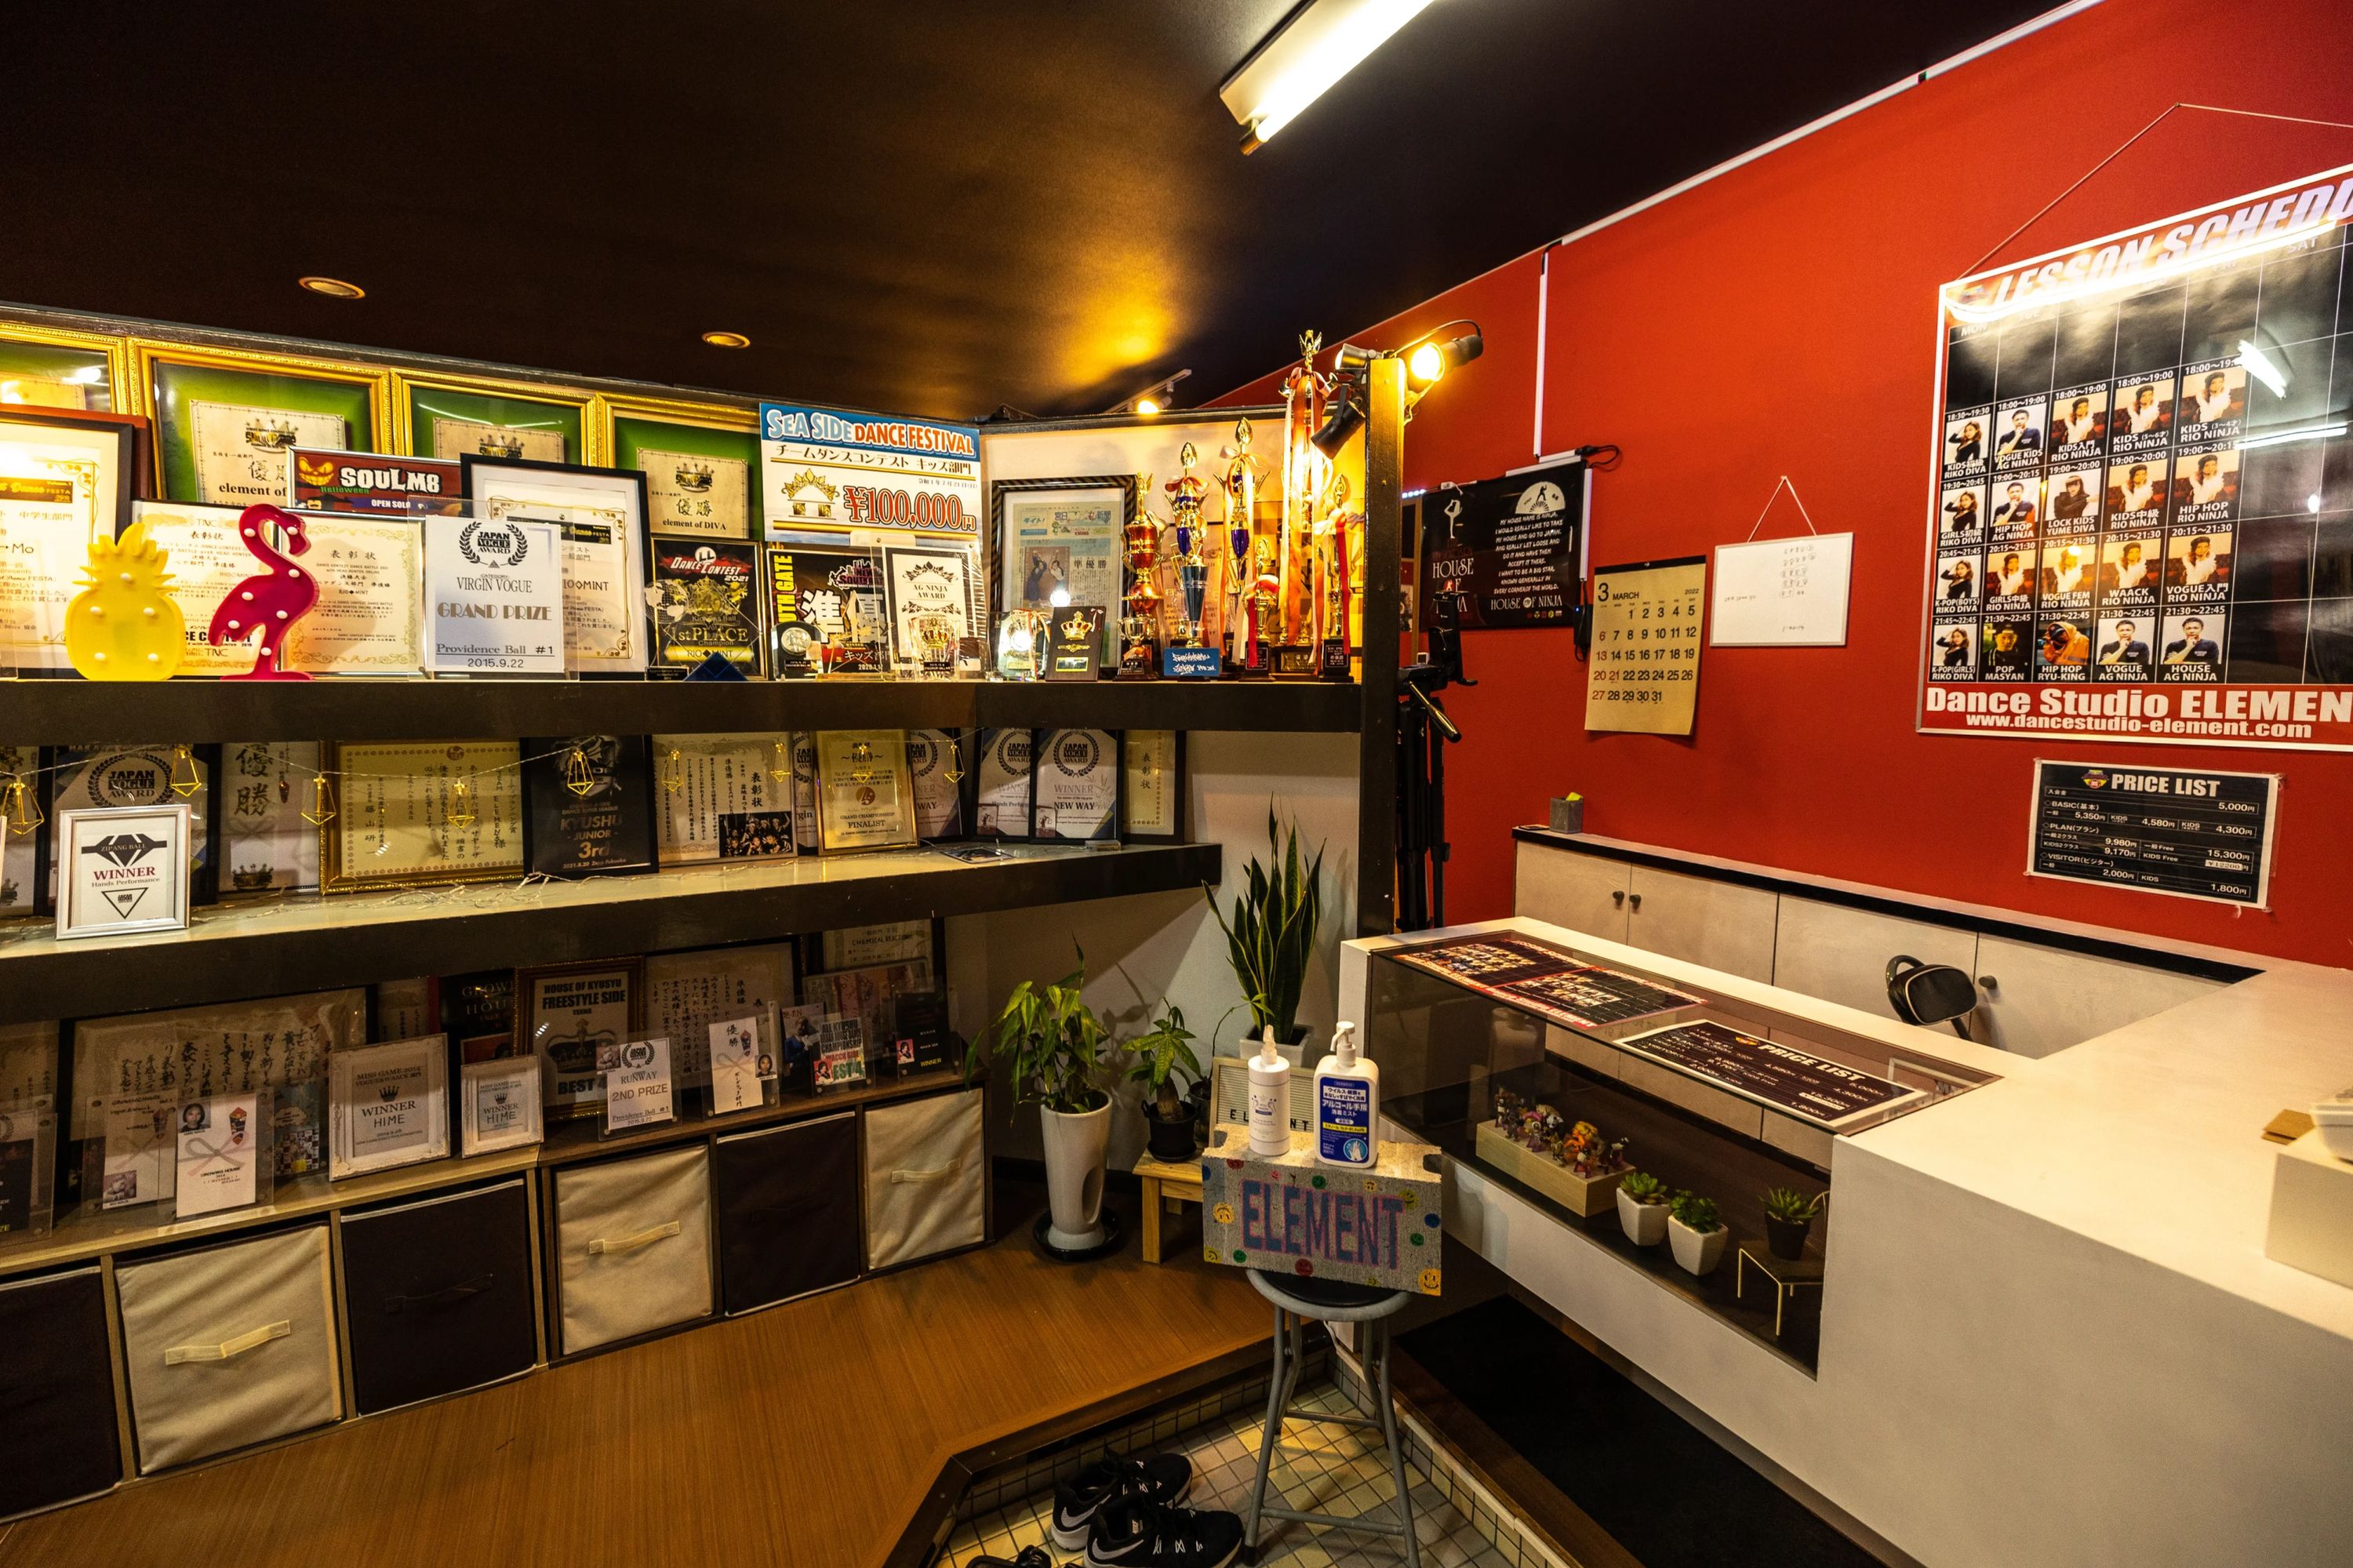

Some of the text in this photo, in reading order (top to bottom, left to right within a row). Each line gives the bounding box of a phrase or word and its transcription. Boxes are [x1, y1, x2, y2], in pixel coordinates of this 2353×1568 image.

[2287, 237, 2318, 253] SAT
[1996, 235, 2155, 305] LESSON
[767, 409, 974, 455] SEA SIDE DANCE FESTIVAL
[2180, 423, 2208, 434] KIDS
[2180, 427, 2240, 442] RIO NINJA
[2113, 434, 2138, 445] KIDS
[776, 445, 971, 475] チームダンスコンテスト キッズ部門
[2051, 448, 2101, 462] RIO NINJA
[1944, 466, 1986, 478] RIKO DIVA
[340, 467, 440, 494] SOULM8
[219, 483, 270, 495] element
[676, 498, 713, 517] 優勝
[2180, 502, 2228, 514] HIP HOP
[20, 512, 73, 521] 中学生部門
[2048, 518, 2071, 528] LOCK
[2046, 526, 2071, 535] YUME
[478, 540, 510, 548] VOGUE
[331, 550, 376, 560] 表彰状
[1075, 558, 1106, 569] 準優勝
[1433, 558, 1474, 578] HOUSE
[774, 555, 795, 591] GATE
[457, 577, 532, 593] VIRGIN VOGUE
[2166, 584, 2228, 594] VOGUE入門
[2110, 588, 2149, 597] WAACK
[1491, 598, 1521, 610] HOUSE
[1539, 595, 1562, 606] NINJA
[438, 602, 551, 620] GRAND PRIZE
[1643, 606, 1695, 618] 2 5
[693, 628, 748, 642] PLACE
[1656, 627, 1697, 638] 10 12
[205, 648, 228, 657] TNC
[436, 644, 500, 653] Providence
[505, 645, 526, 653] Ball
[467, 658, 524, 668] 2015.9.22
[1667, 670, 1693, 680] 25 26
[2038, 672, 2086, 681] RYU-KING
[2182, 672, 2217, 681] NINJA
[1926, 687, 2031, 712] Dance
[2040, 689, 2168, 718] Studio
[1966, 713, 2311, 738] www.dancestudio-element.com
[108, 770, 155, 779] JAPAN
[1140, 751, 1151, 790] 表彰状
[751, 773, 763, 807] 表彰状
[1054, 784, 1093, 793] WINNER
[2111, 774, 2220, 797] PRICE LIST
[108, 789, 155, 798] AWARD
[573, 830, 611, 840] JUNIOR
[578, 841, 609, 858] 3rd
[94, 867, 155, 880] WINNER
[117, 877, 160, 886] Performance
[544, 979, 621, 994] HOUSE OF KYUSYU
[543, 991, 625, 1010] FREESTYLE SIDE
[726, 1024, 739, 1046] 優勝
[920, 1058, 941, 1067] WINNER
[378, 1068, 402, 1078] GAME
[621, 1071, 657, 1084] RUNWAY
[558, 1079, 595, 1094] BEST
[613, 1084, 667, 1101] 2ND PRIZE
[362, 1101, 416, 1117] WINNER
[374, 1114, 405, 1128] HIME
[1240, 1179, 1406, 1271] ELEMENT
